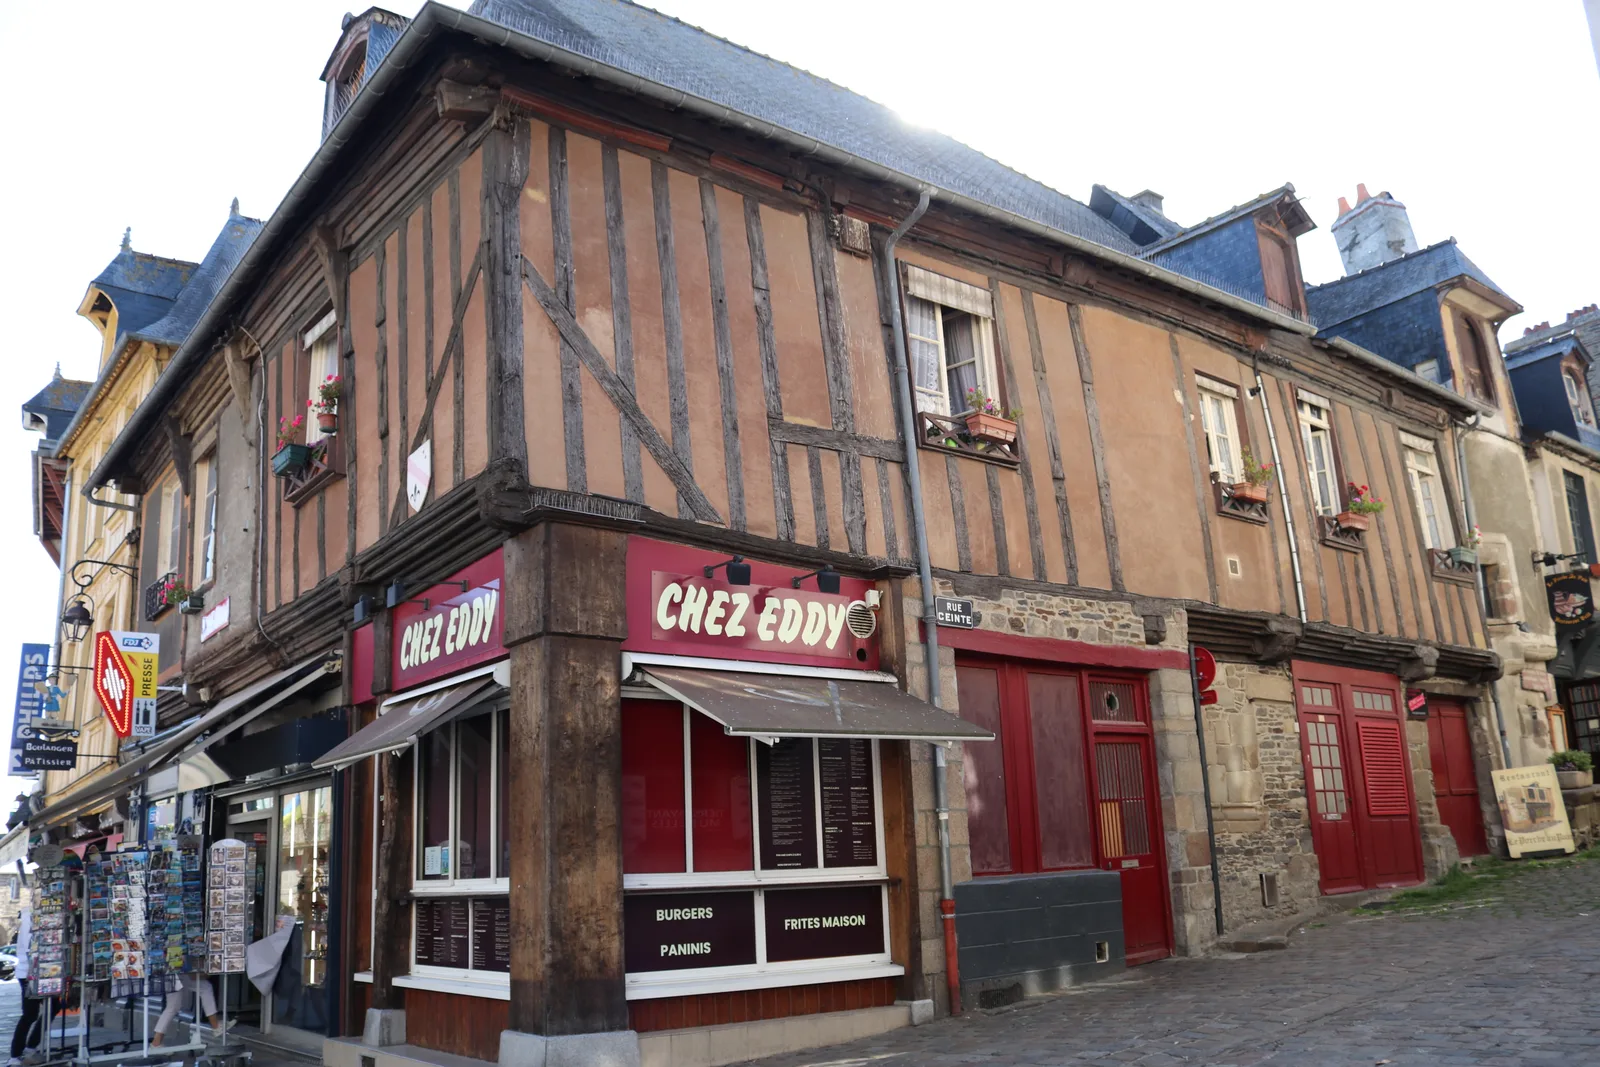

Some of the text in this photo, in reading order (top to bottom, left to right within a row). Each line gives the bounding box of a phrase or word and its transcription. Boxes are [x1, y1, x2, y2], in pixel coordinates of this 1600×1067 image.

[946, 603, 962, 612] RUE
[656, 583, 846, 650] CHEZ EDDY
[938, 612, 971, 624] CEINTE
[400, 589, 497, 671] CHEZ EDDY
[123, 638, 140, 646] FDJ
[142, 658, 153, 696] PRESSE
[135, 726, 152, 734] VAPE
[656, 907, 713, 921] BURGERS
[784, 914, 866, 931] FRITES MAISON
[660, 942, 711, 957] PANINIS
